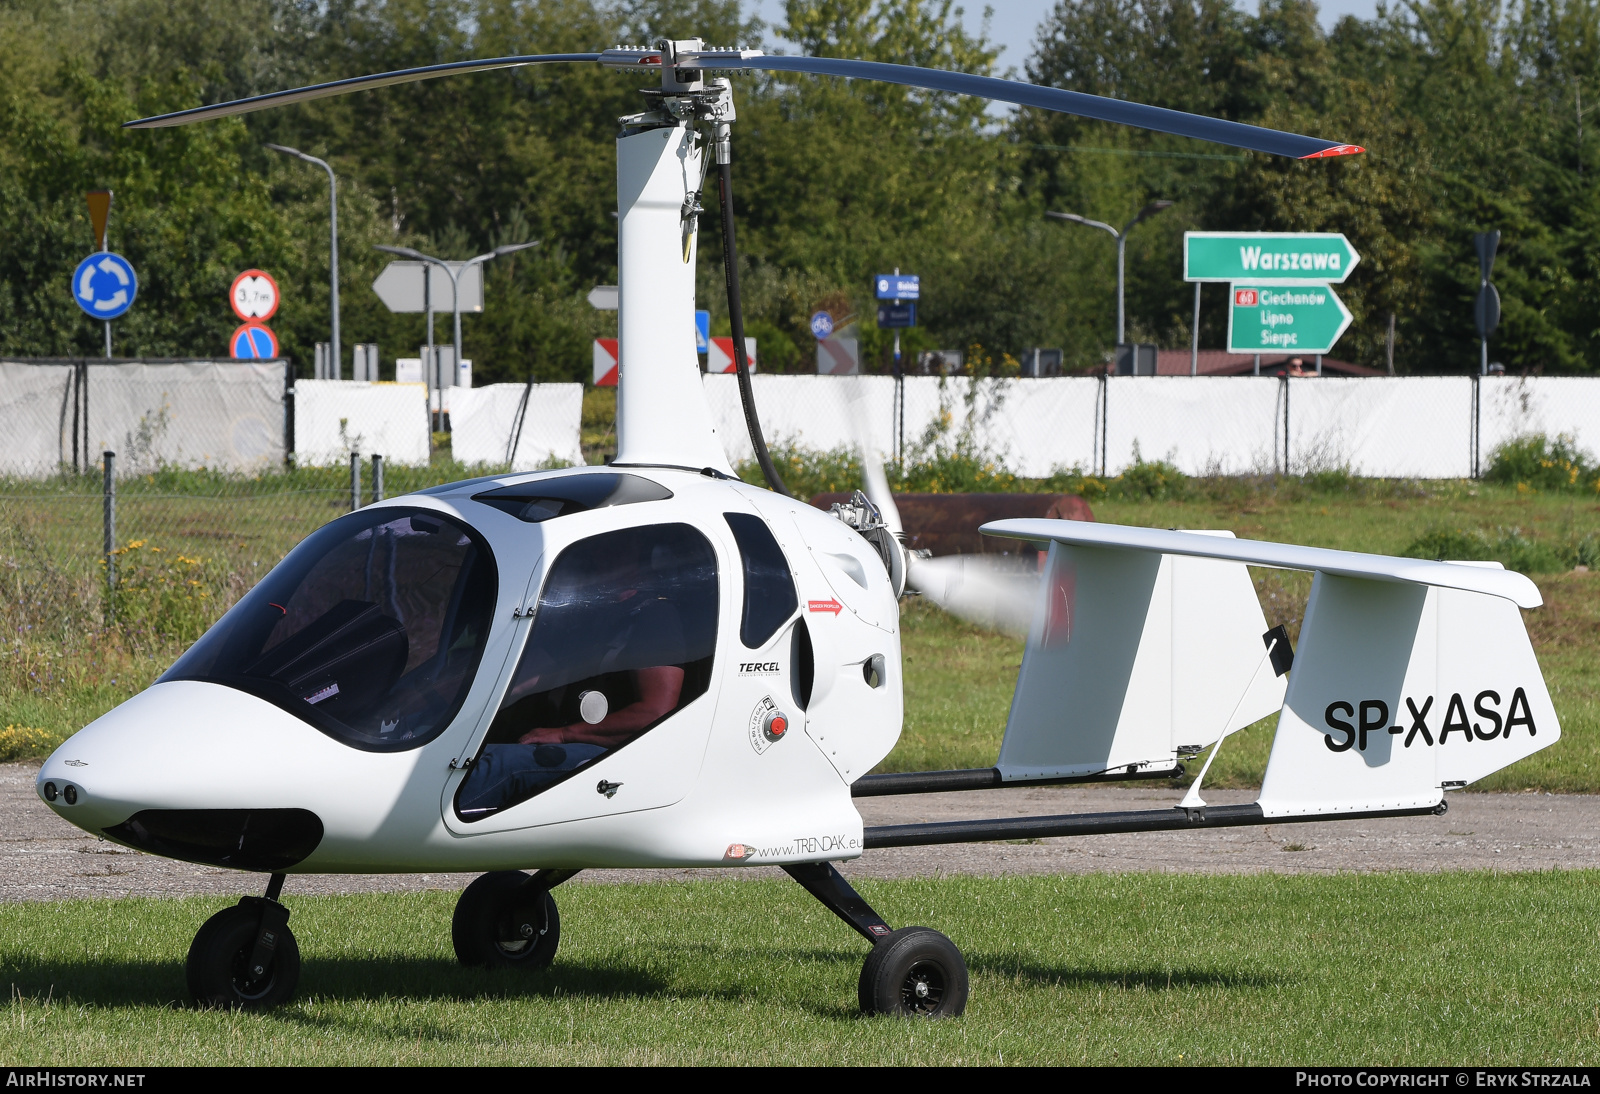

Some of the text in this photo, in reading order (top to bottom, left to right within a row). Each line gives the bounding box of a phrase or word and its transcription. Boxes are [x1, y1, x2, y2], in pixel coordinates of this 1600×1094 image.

[1239, 245, 1341, 271] Warszawa
[1239, 290, 1326, 306] 60 Ciechanów
[1260, 310, 1294, 328] Lipno
[1260, 329, 1298, 348] Sierpc
[739, 661, 780, 673] TERCEL
[1324, 686, 1537, 753] SP-XASA
[754, 738, 762, 751] FUEL
[758, 834, 863, 858] www.TRENDAK.eu
